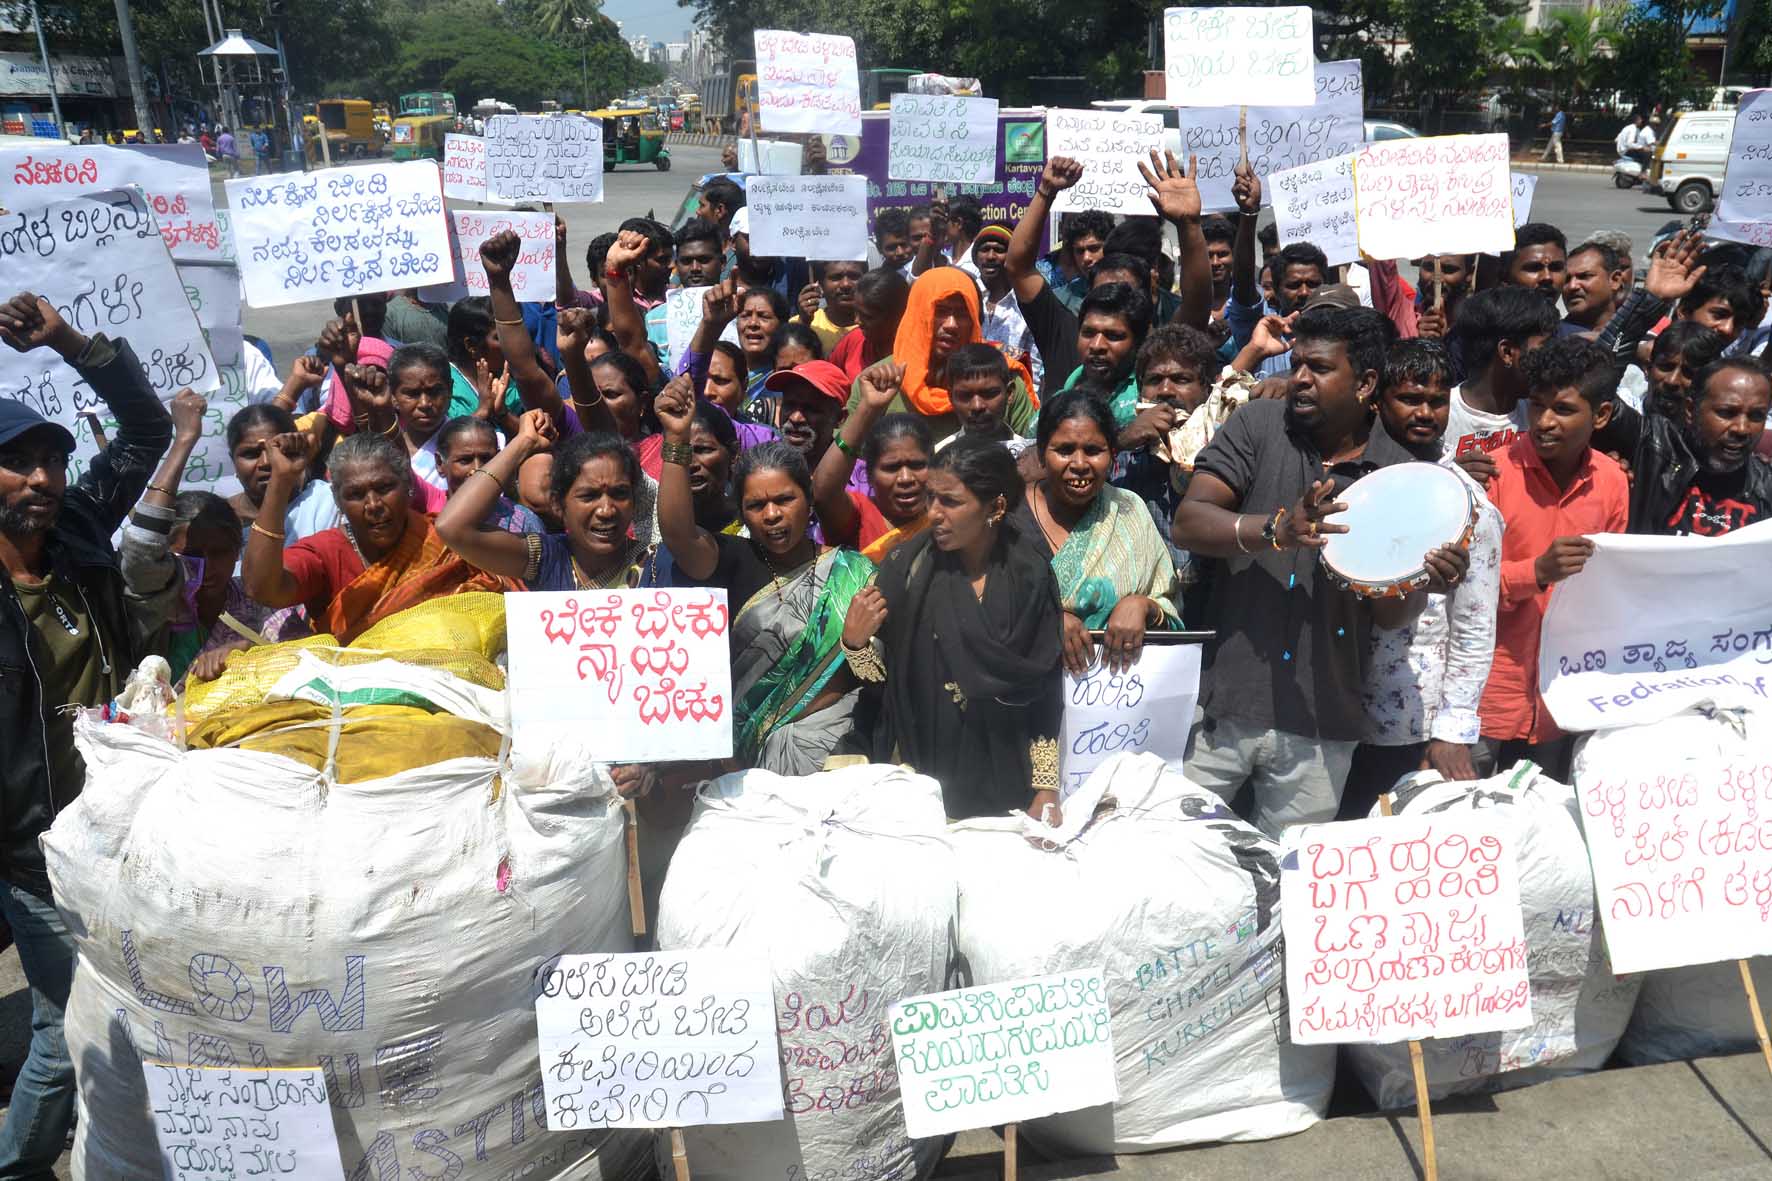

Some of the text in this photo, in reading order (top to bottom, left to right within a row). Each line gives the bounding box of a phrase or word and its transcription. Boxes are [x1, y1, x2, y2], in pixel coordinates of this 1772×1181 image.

[1005, 164, 1043, 174] Kartavya
[631, 590, 729, 640] ಬೇಕು
[1560, 626, 1772, 677] ಒಣ ತ್ಯಾಜ್ಯ ಸಂಗ್ರ
[633, 677, 724, 726] ಬೇಕು
[120, 929, 366, 1033] LOW
